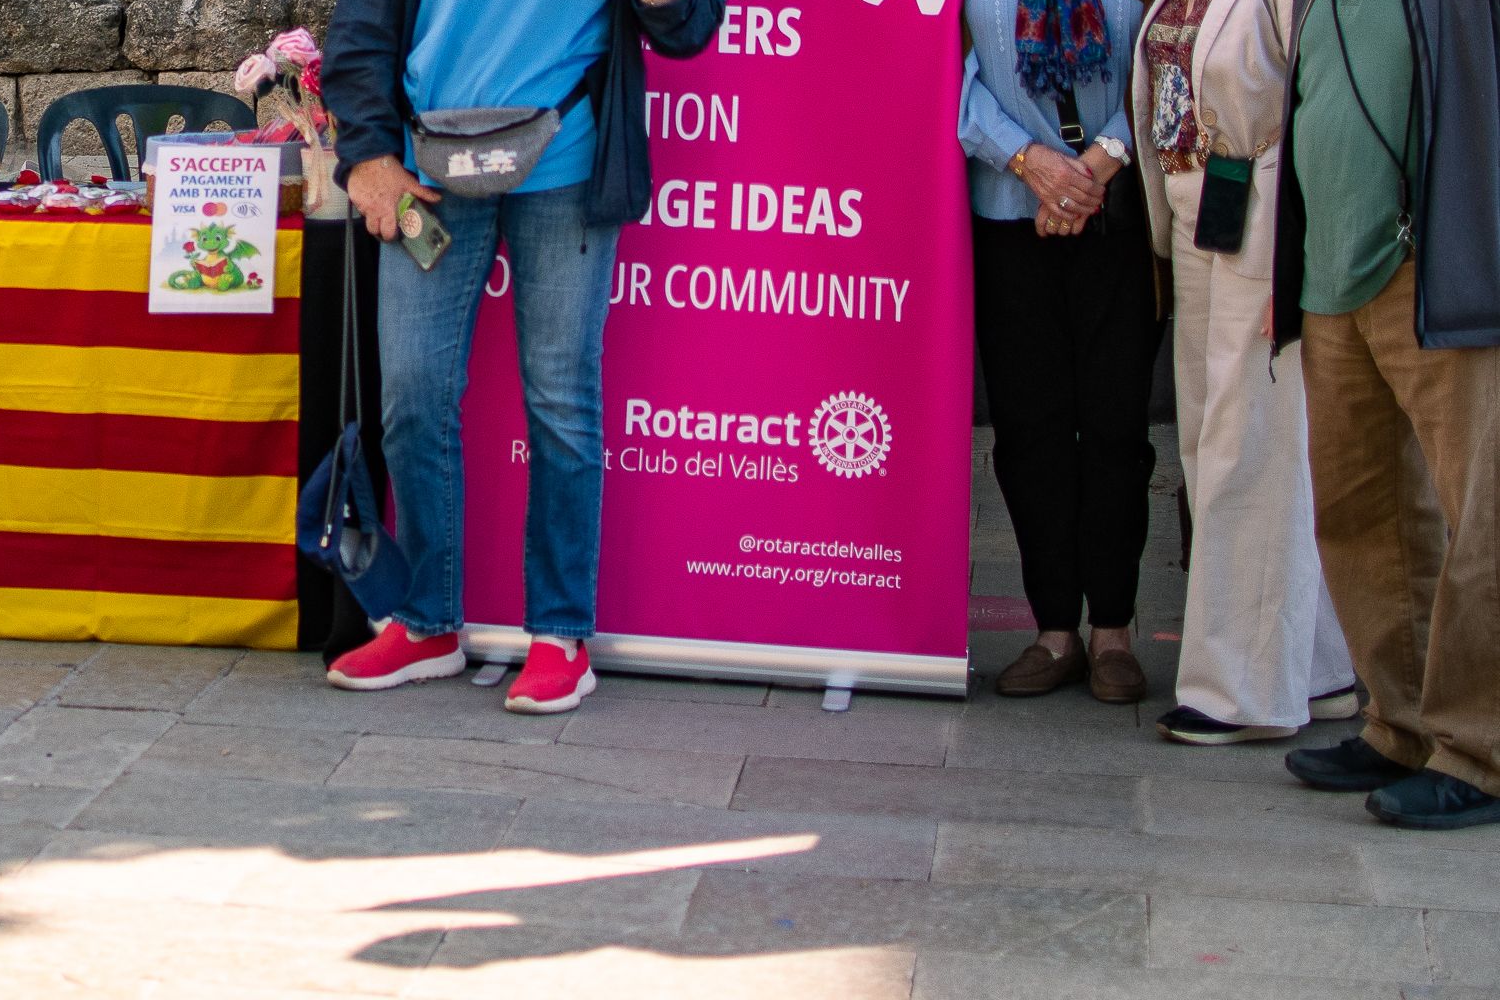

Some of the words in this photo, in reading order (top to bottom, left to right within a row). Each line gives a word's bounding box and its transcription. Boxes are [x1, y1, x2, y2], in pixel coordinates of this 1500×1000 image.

[169, 157, 266, 172] S'ACCEPTA
[180, 175, 253, 186] PAGAMENT
[169, 188, 200, 199] AMB
[203, 188, 263, 199] TARGETA
[172, 205, 196, 213] VISA
[730, 183, 863, 238] IDEAS
[664, 264, 910, 323] COMMUNITY
[834, 401, 870, 412] ROTARY
[625, 398, 801, 447] Rotaract
[620, 448, 678, 475] Club
[685, 451, 723, 477] del
[729, 454, 799, 482] Vallès
[821, 446, 881, 469] INTERNATIONAL
[739, 535, 902, 563] @rotaractdelvalles
[686, 560, 902, 589] www.rotary.org/rotaract
